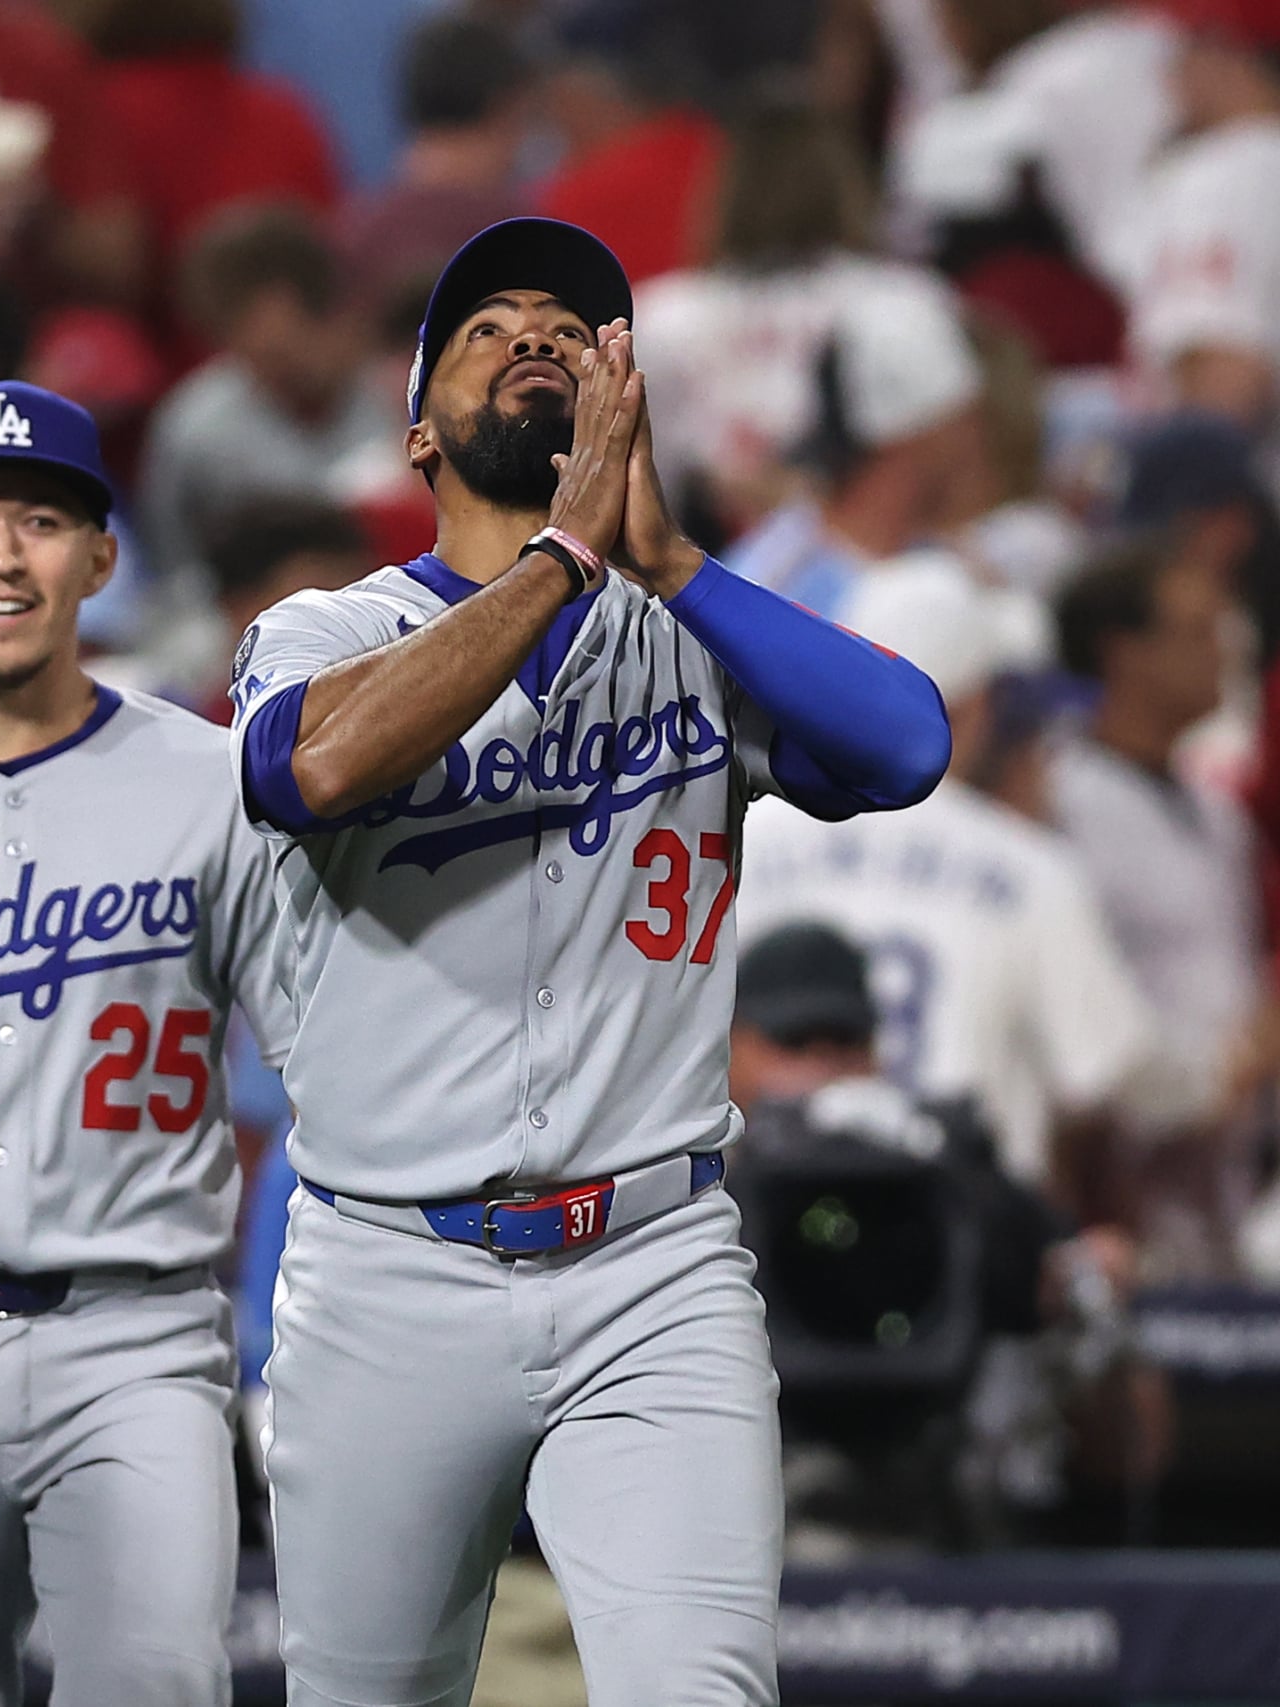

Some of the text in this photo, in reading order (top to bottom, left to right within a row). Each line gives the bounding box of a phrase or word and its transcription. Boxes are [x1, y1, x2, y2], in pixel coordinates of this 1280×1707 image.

[625, 828, 734, 964] 37
[82, 1002, 211, 1133] 25
[570, 1199, 595, 1238] 37
[777, 1588, 1120, 1687] ooking.com
